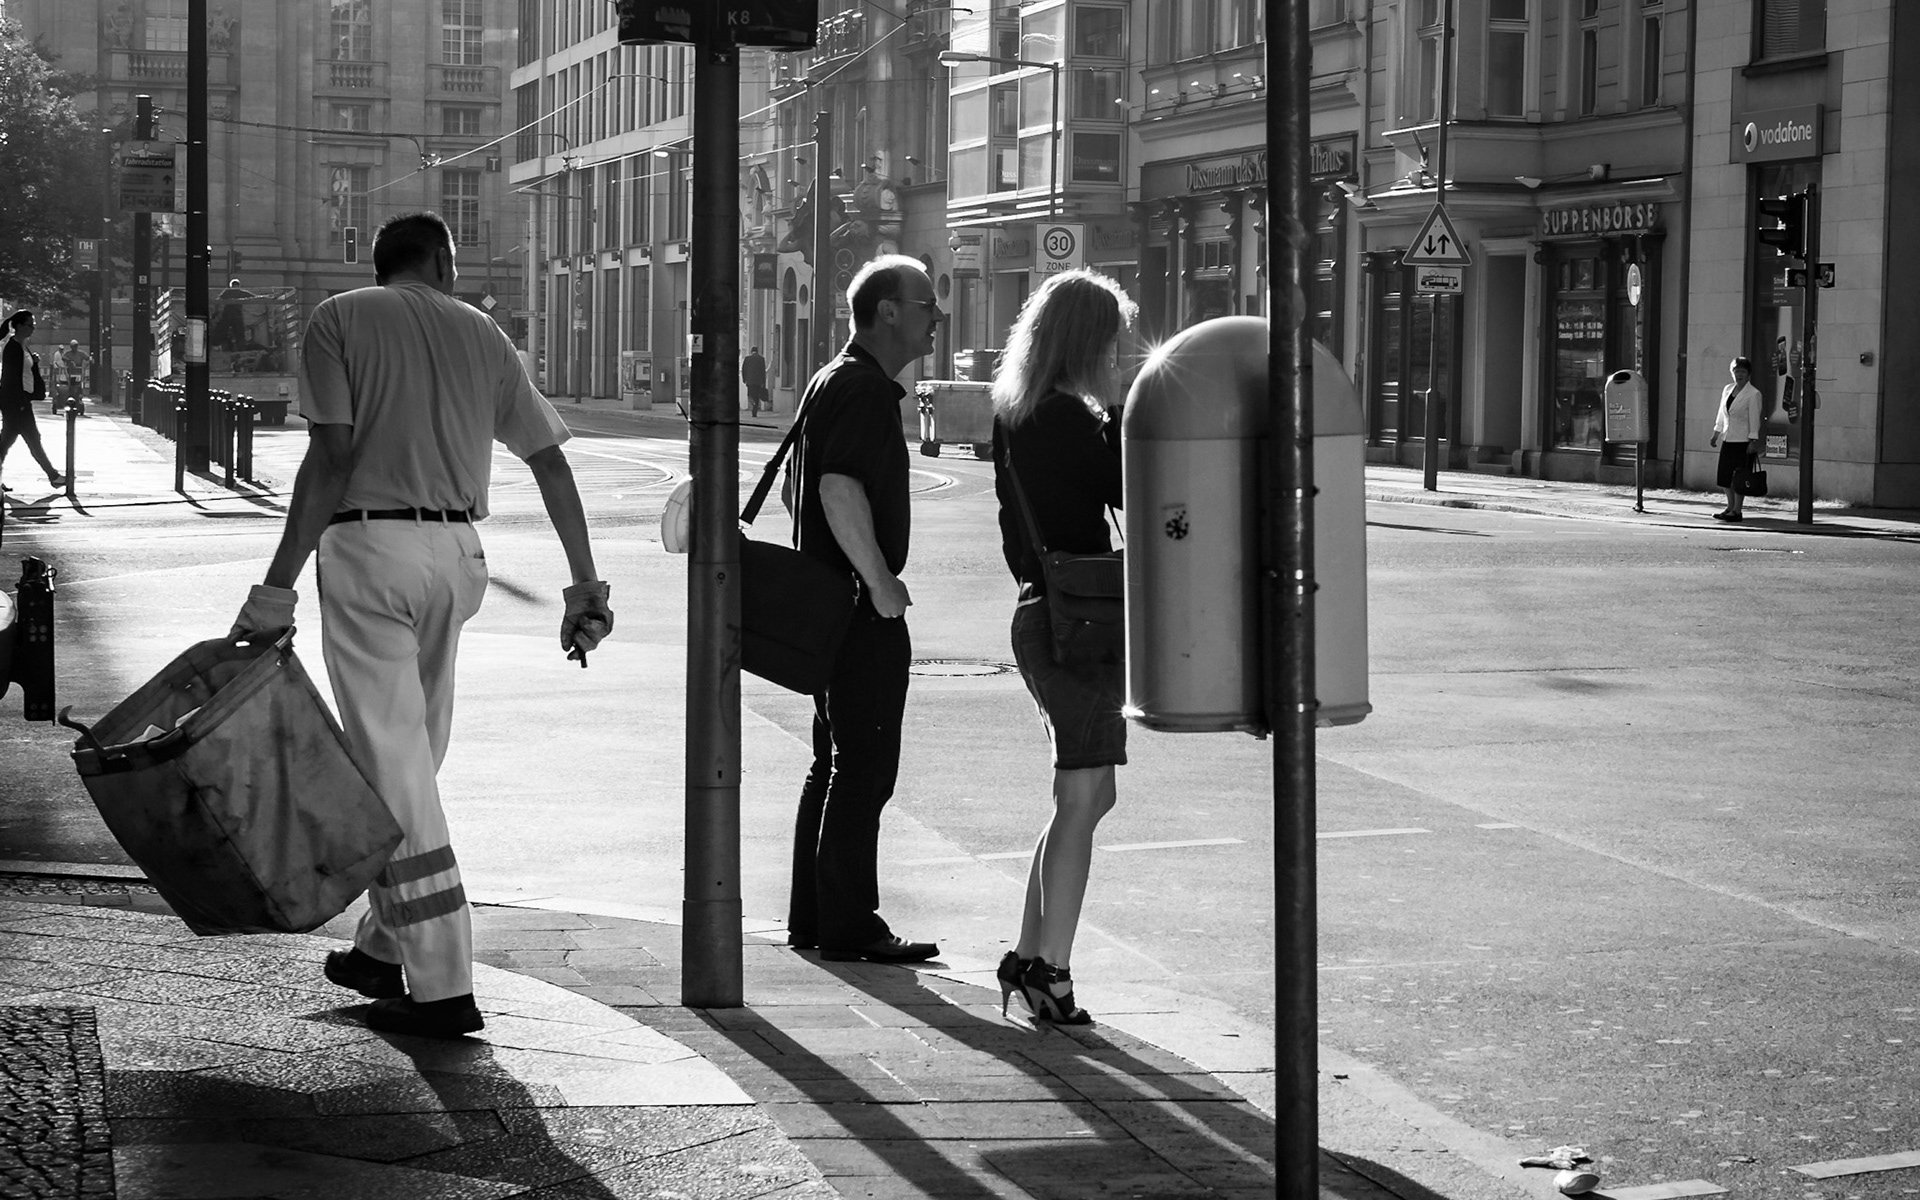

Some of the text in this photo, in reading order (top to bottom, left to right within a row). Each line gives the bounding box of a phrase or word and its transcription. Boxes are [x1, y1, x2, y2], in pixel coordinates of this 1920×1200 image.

[1760, 120, 1812, 145] vodafone
[124, 158, 172, 167] fahrradstation
[1185, 163, 1235, 190] Dussmann
[1235, 155, 1253, 184] das
[1048, 235, 1069, 252] 30
[1046, 262, 1072, 271] ZONE
